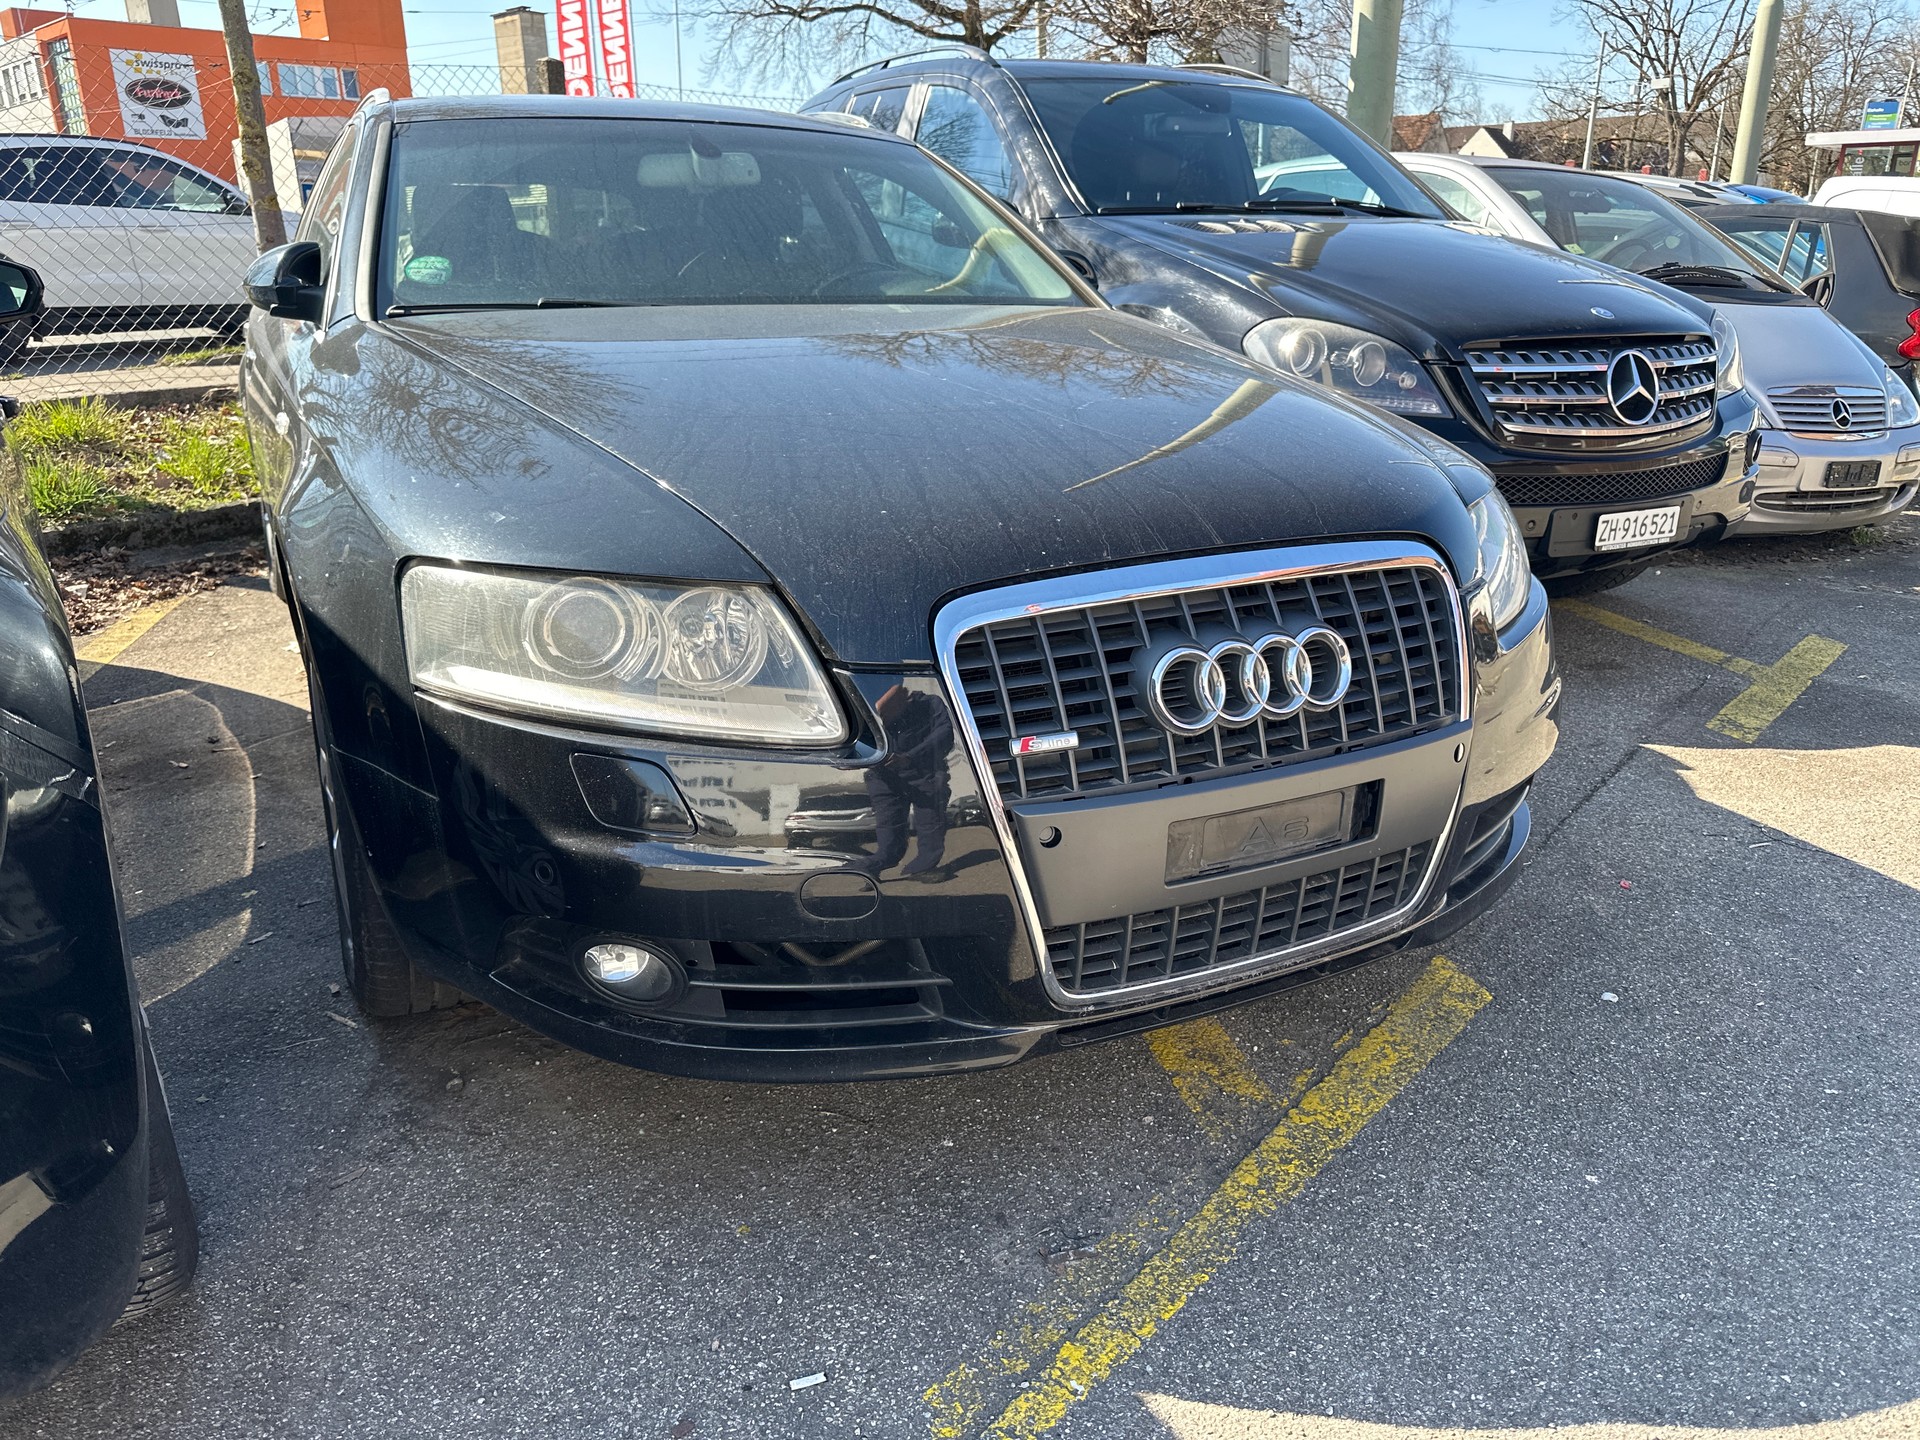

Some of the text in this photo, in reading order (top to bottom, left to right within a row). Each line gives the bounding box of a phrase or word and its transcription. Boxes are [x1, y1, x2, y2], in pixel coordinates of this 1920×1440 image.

[561, 0, 591, 96] DENN
[1047, 737, 1071, 748] line
[1241, 815, 1309, 852] A6
